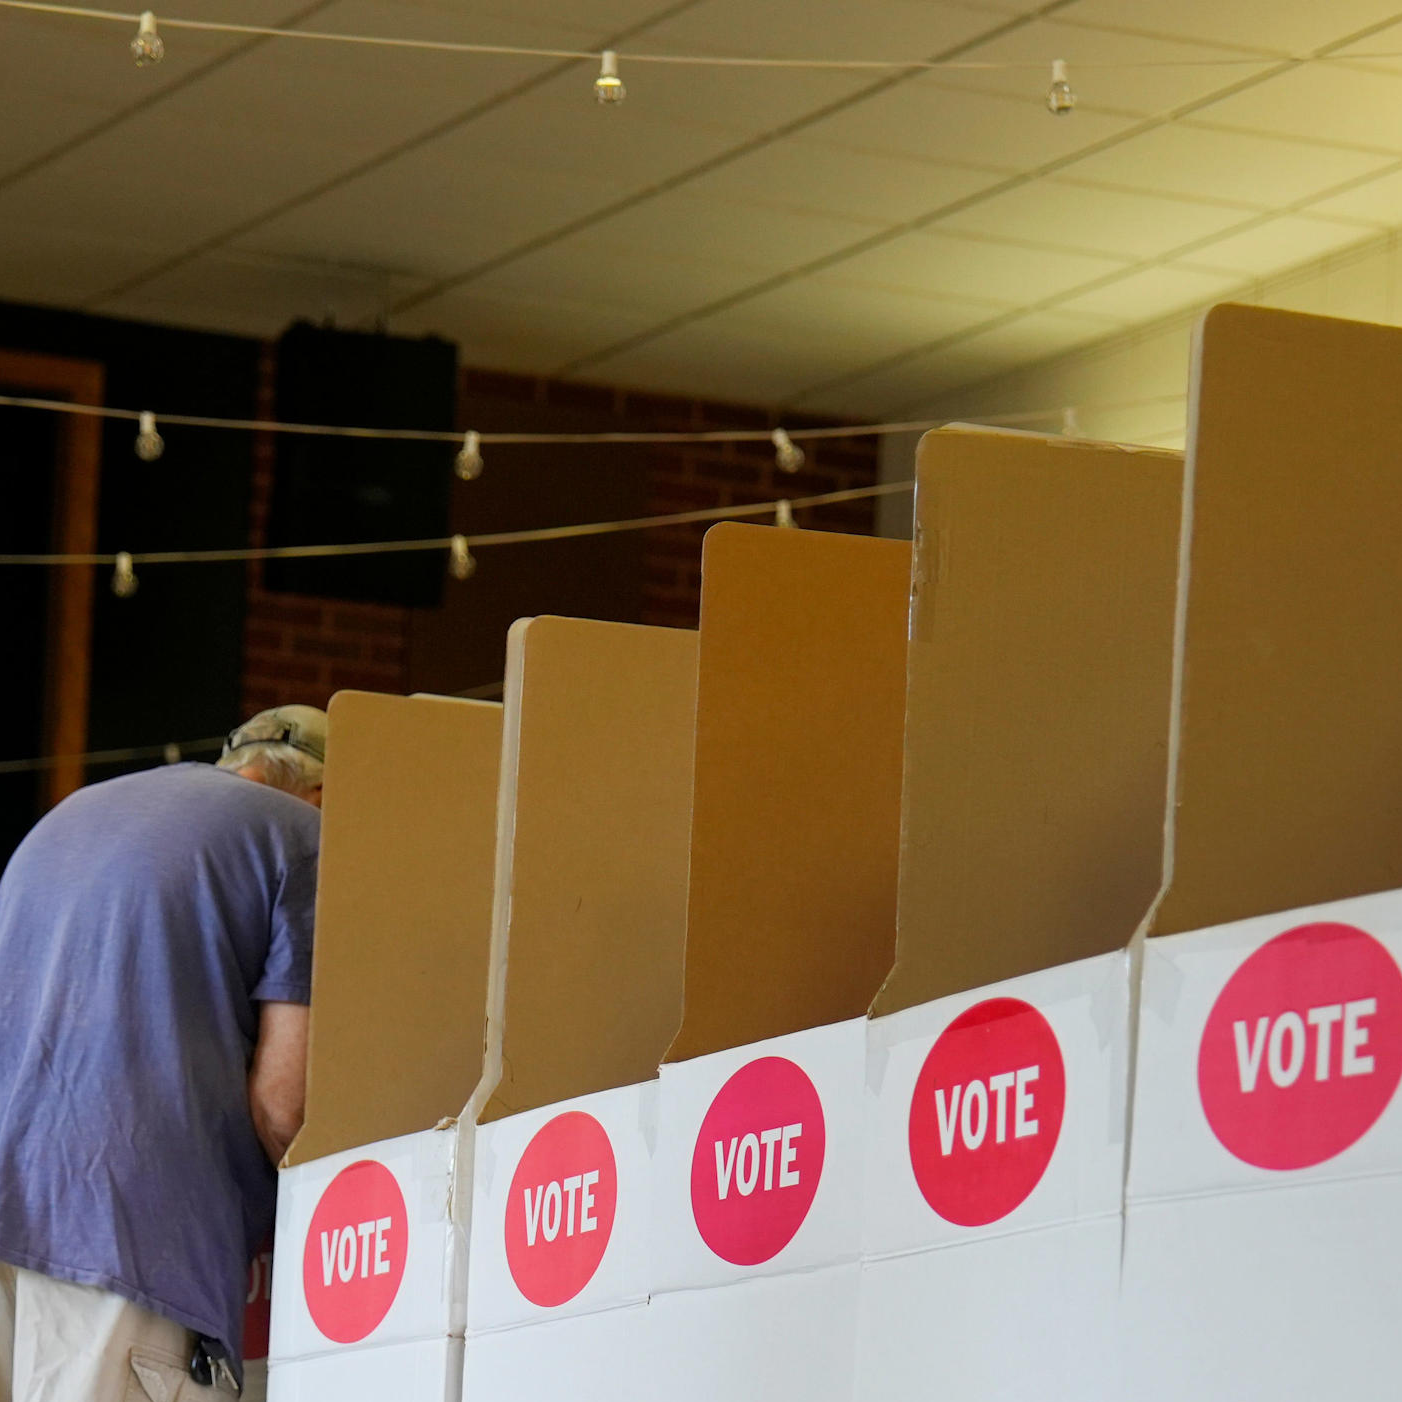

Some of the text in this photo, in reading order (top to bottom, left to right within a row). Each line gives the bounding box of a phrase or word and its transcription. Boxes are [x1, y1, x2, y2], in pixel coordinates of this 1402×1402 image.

[1233, 998, 1376, 1093] VOTE
[934, 1065, 1039, 1156] VOTE
[714, 1122, 802, 1200] VOTE
[523, 1169, 599, 1246] VOTE
[320, 1215, 392, 1287] VOTE
